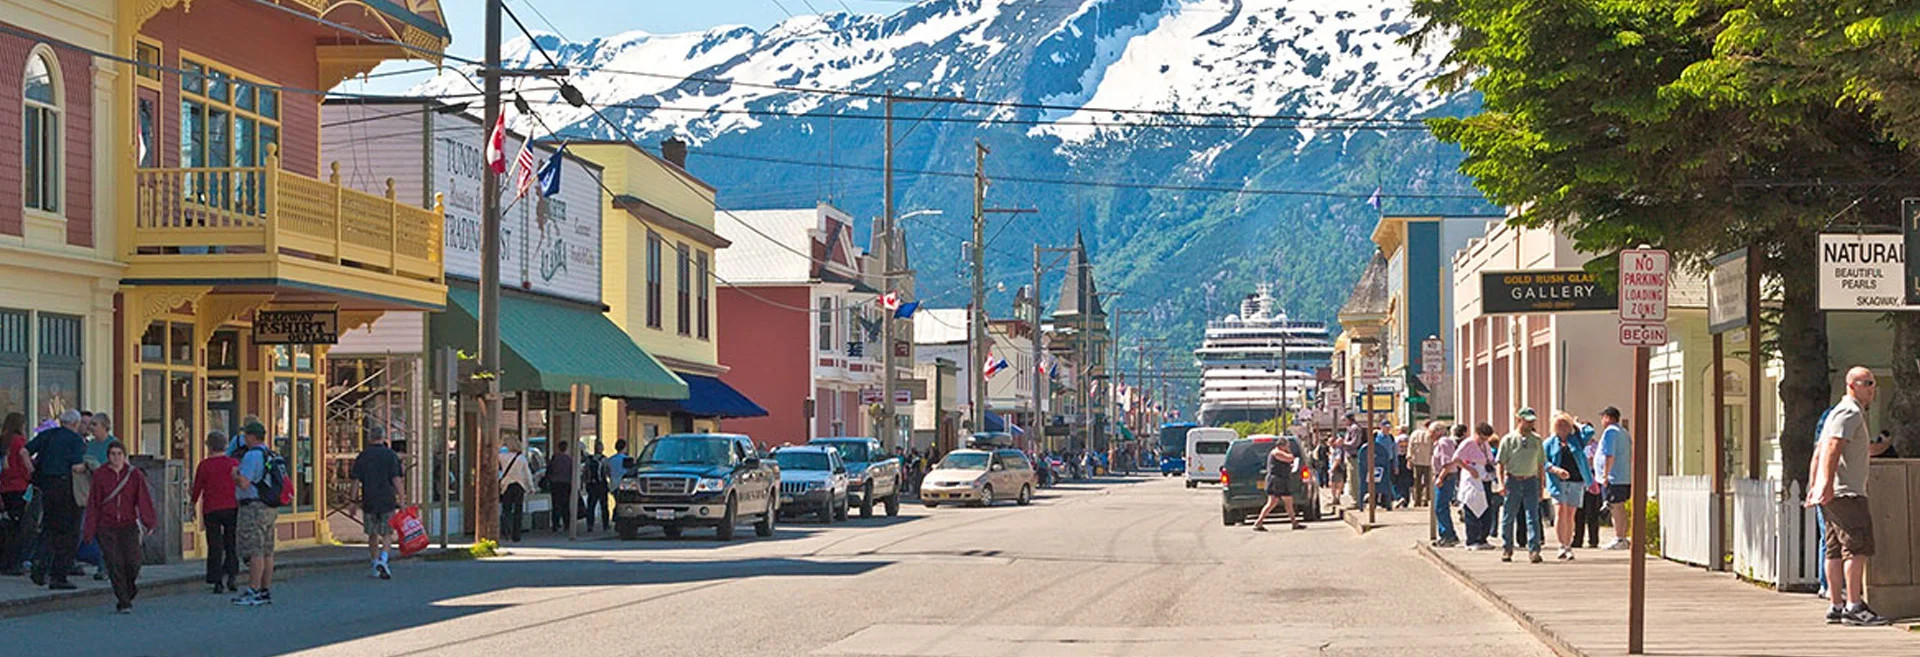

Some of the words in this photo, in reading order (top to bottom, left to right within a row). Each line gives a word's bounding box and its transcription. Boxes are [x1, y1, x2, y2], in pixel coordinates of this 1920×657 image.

[1635, 257, 1653, 271] NO
[1504, 276, 1532, 284] GOLD
[1535, 274, 1564, 283] RUSH
[1568, 273, 1597, 283] GLAS
[1624, 272, 1664, 286] PARKING
[1834, 267, 1884, 278] BEAUTIFUL
[1841, 279, 1877, 290] PEARLS
[1511, 285, 1595, 300] GALLERY
[1625, 288, 1662, 301] LOADING
[1631, 302, 1657, 315] ZONE
[256, 320, 327, 334] T-SHIRT
[1623, 328, 1664, 341] BEGIN
